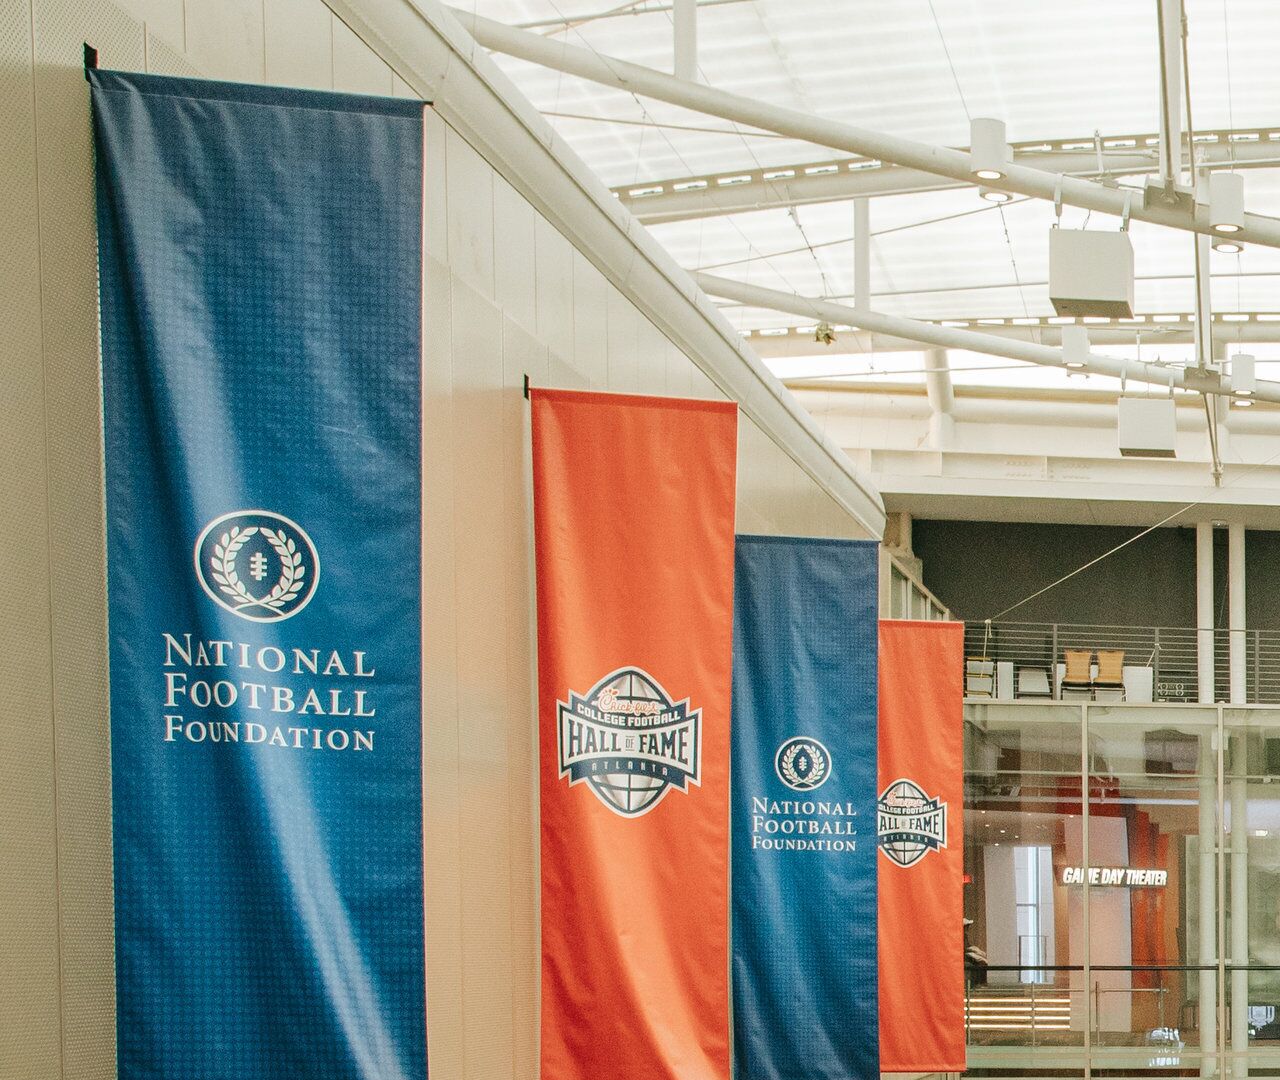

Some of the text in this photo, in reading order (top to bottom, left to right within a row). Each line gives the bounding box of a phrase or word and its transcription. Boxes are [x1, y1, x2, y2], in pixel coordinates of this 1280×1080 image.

[162, 633, 375, 677] NATIONAL
[163, 672, 376, 717] FOOTBALL
[577, 703, 681, 727] COLLEGE FOOTBALL
[163, 715, 375, 751] FOUNDATION
[567, 718, 689, 764] HALL OF FAME
[591, 761, 668, 777] ATLANTA
[752, 797, 857, 816] NATIONAL
[878, 803, 901, 815] OLLEGE
[753, 816, 857, 835] FOOTBALL
[880, 813, 940, 836] ALL FAME
[752, 835, 856, 851] FOUNDATION
[1102, 868, 1125, 885] DAY
[1125, 869, 1168, 886] THEATER
